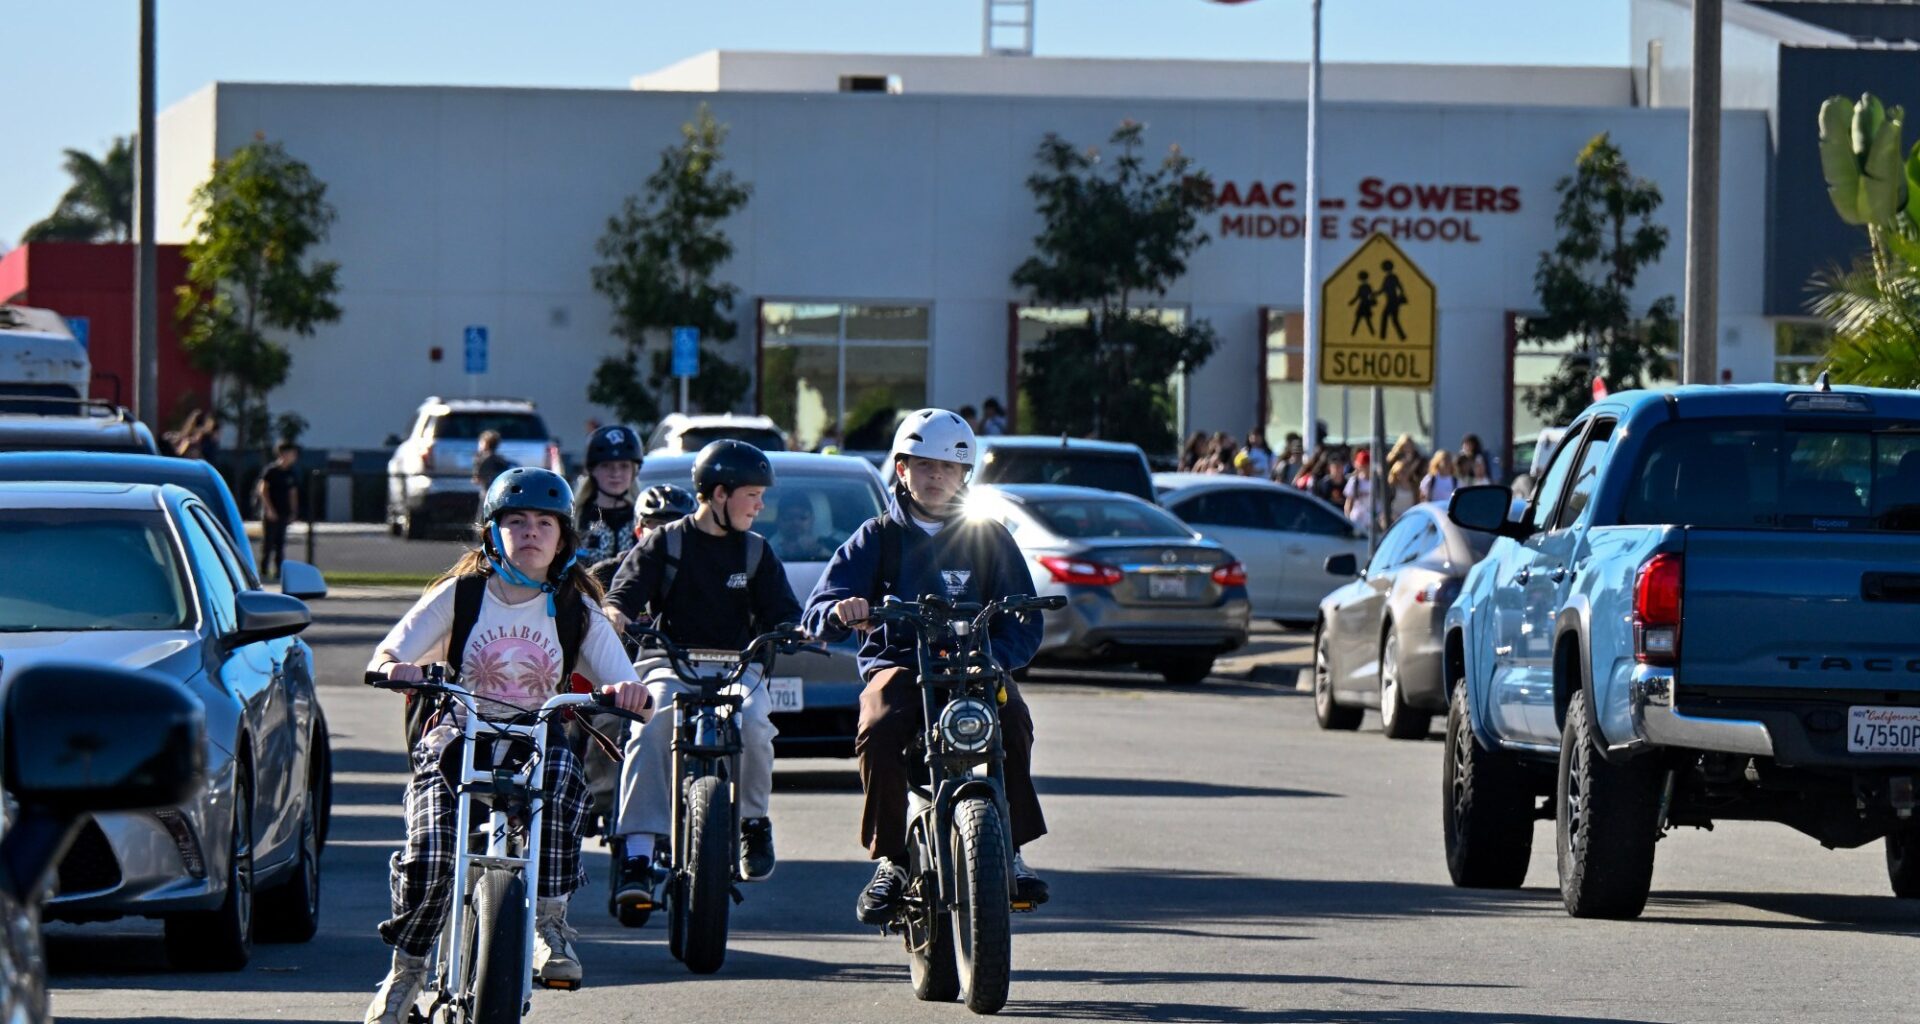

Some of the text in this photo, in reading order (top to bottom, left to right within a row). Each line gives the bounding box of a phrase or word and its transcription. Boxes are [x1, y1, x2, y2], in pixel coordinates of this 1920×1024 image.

[1182, 176, 1296, 210] AAC
[1358, 176, 1521, 213] SOWERS
[1220, 213, 1481, 242] MIDDE SCHOOL
[1332, 351, 1421, 379] SCHOOL
[471, 624, 557, 659] BILLABONG
